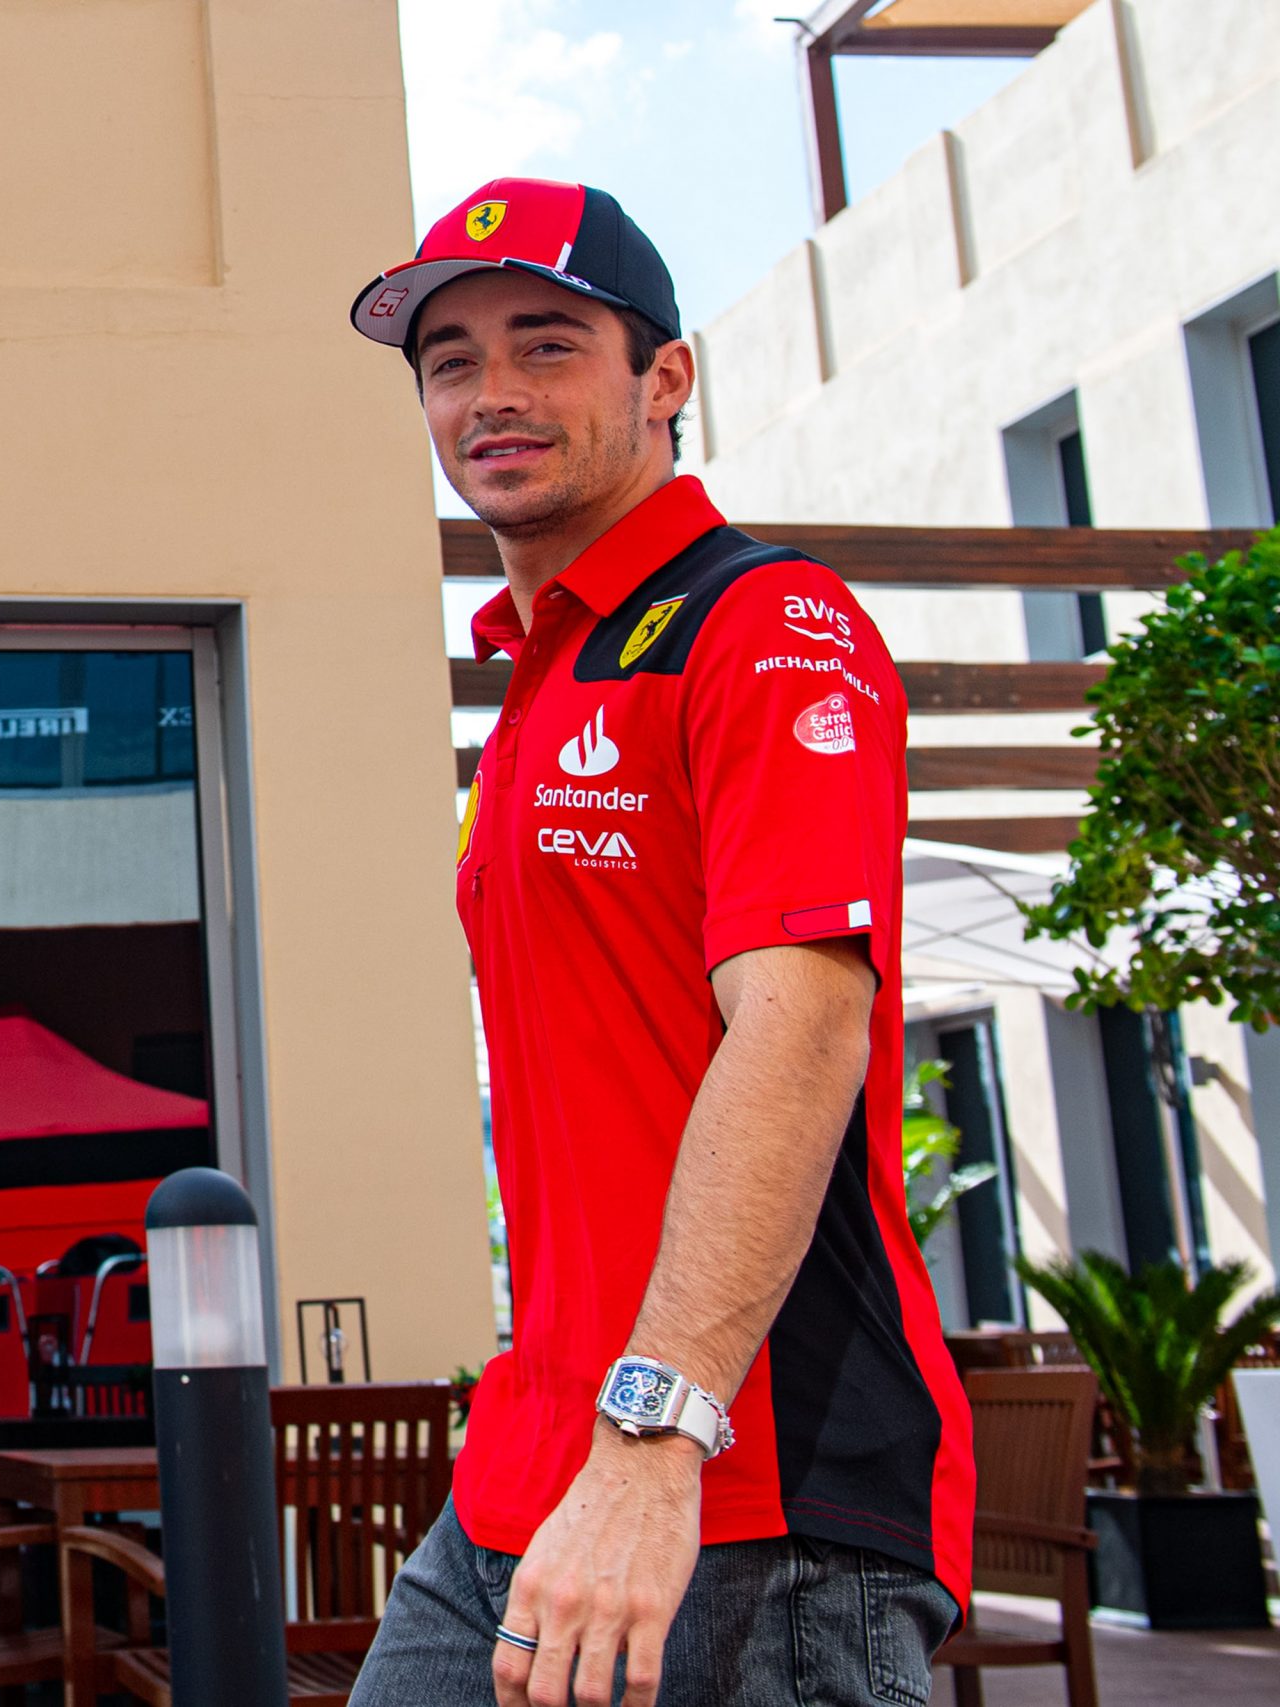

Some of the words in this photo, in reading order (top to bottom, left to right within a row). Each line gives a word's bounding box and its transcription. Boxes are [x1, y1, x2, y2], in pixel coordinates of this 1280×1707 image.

[783, 595, 851, 637] aws
[754, 656, 842, 674] RICHARD
[842, 667, 880, 705] MILLE
[533, 783, 649, 812] Santander
[574, 858, 638, 870] LOGISTICS
